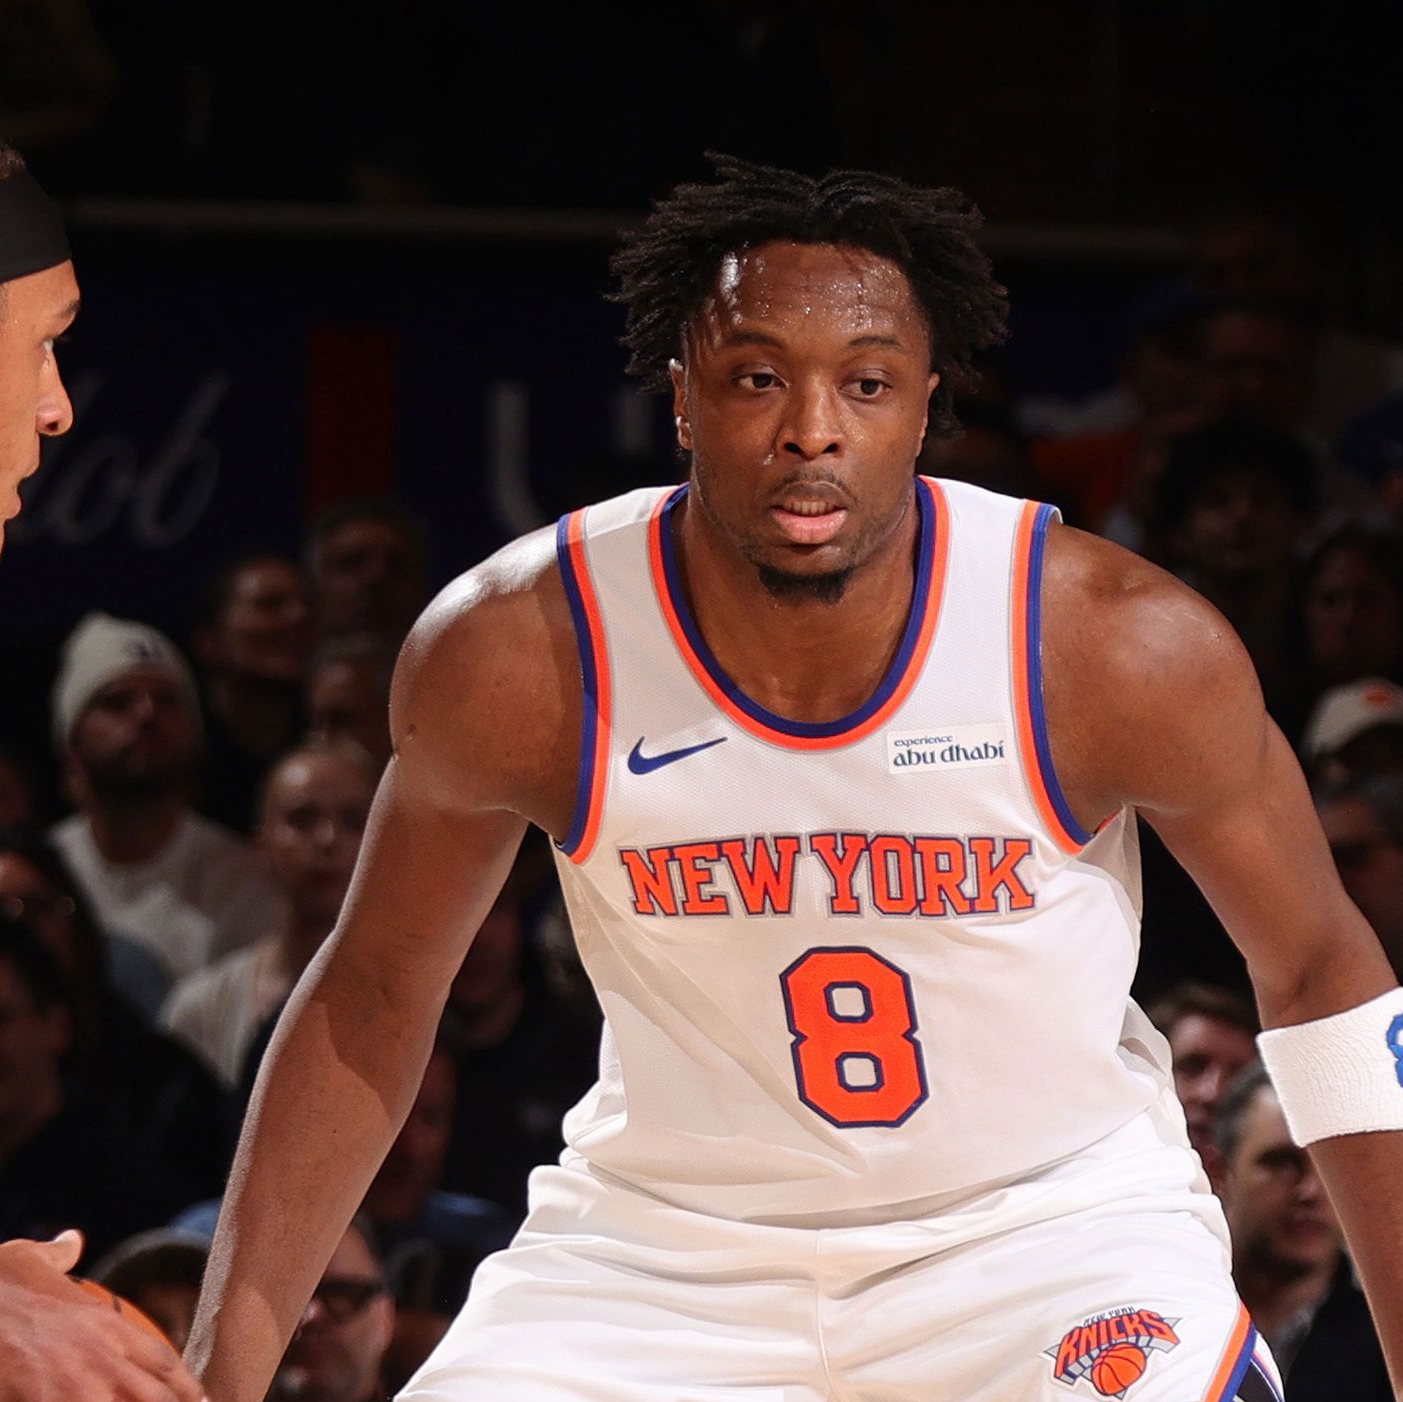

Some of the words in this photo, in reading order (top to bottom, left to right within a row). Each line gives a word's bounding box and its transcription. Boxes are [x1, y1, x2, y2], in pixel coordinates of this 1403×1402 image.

[893, 735, 954, 747] experience
[893, 749, 936, 767] abu
[940, 740, 1006, 763] dhabi
[618, 834, 801, 917] NEW
[810, 833, 1038, 918] YORK
[779, 945, 930, 1129] 8
[1054, 1309, 1181, 1379] KNICKS
[1083, 1313, 1107, 1327] NEW
